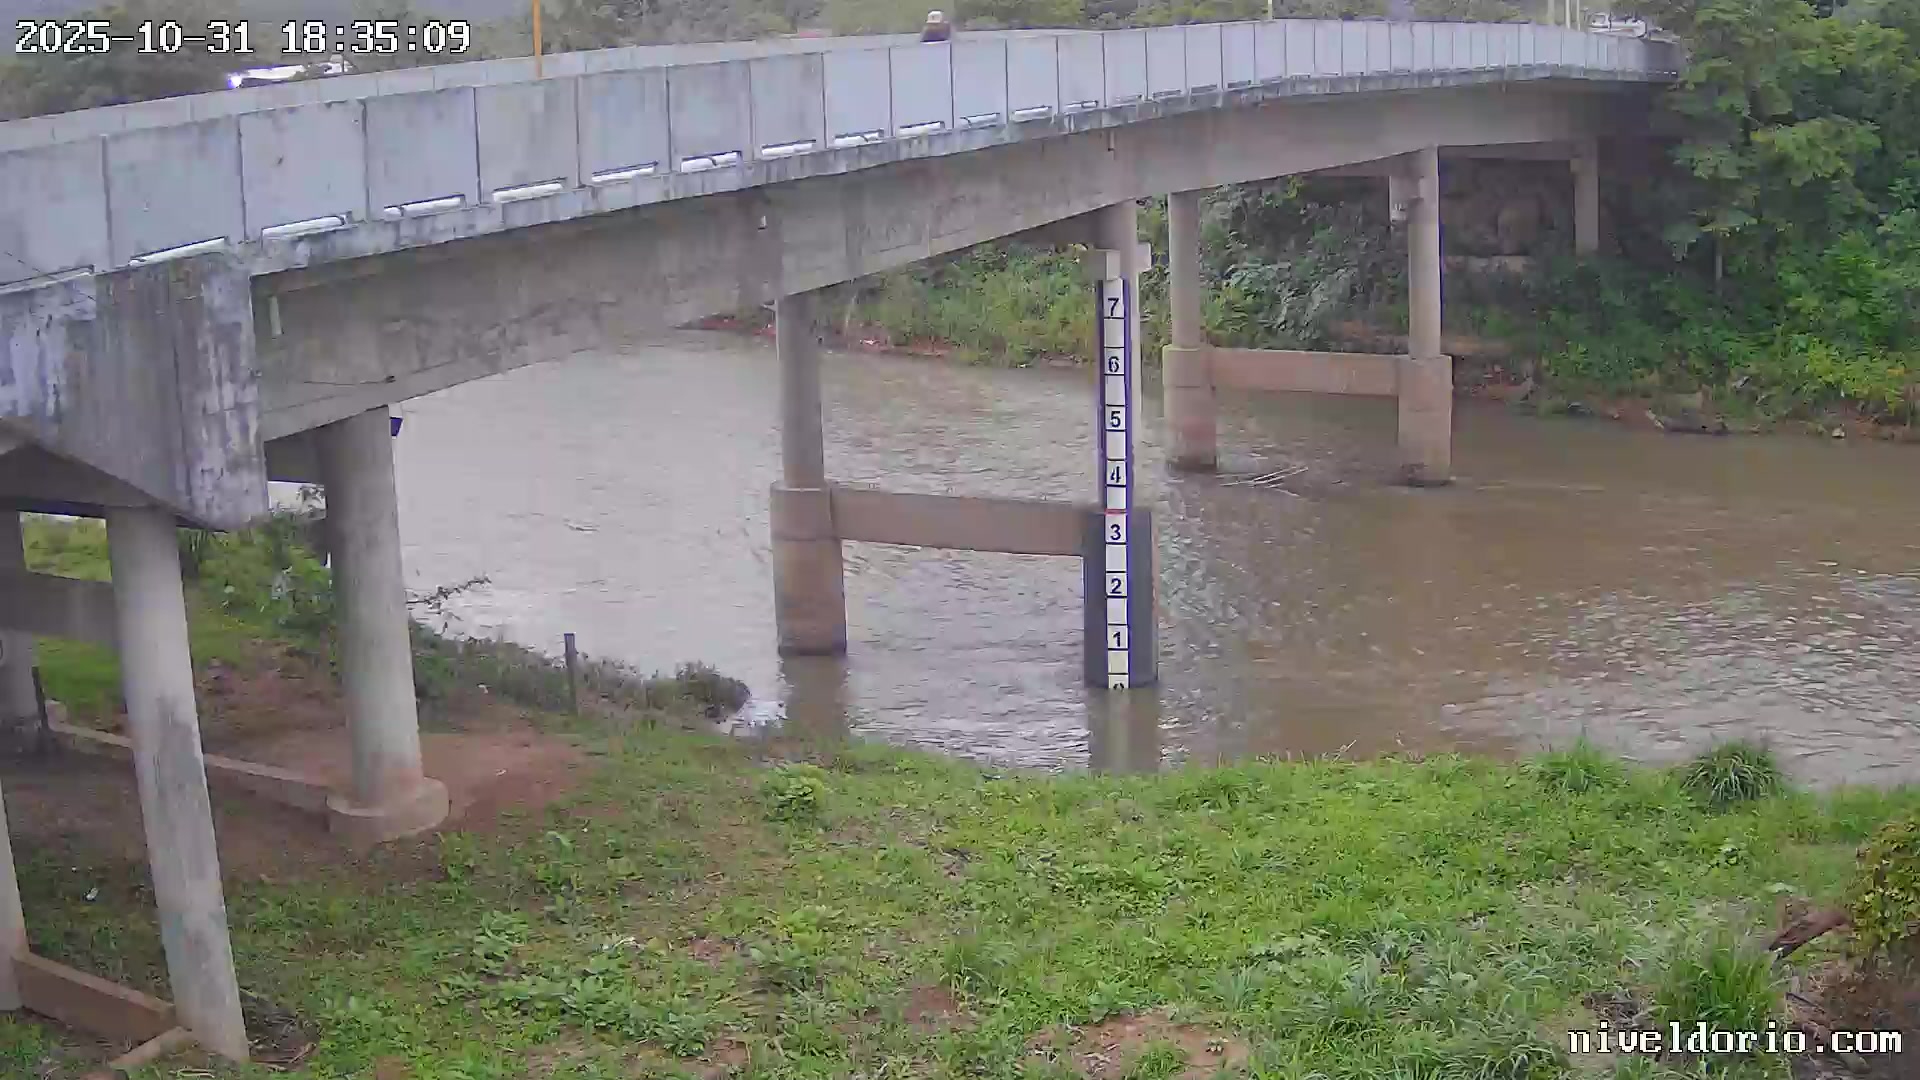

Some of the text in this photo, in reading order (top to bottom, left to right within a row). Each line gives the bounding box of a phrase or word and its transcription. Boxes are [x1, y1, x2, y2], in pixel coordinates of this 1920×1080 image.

[1107, 298, 1119, 316] 7
[1108, 356, 1120, 373] 6
[1109, 411, 1121, 428] 5
[1110, 465, 1121, 483] 4
[1110, 524, 1121, 541] 3
[1110, 578, 1122, 594] 2
[1112, 631, 1121, 647] 1
